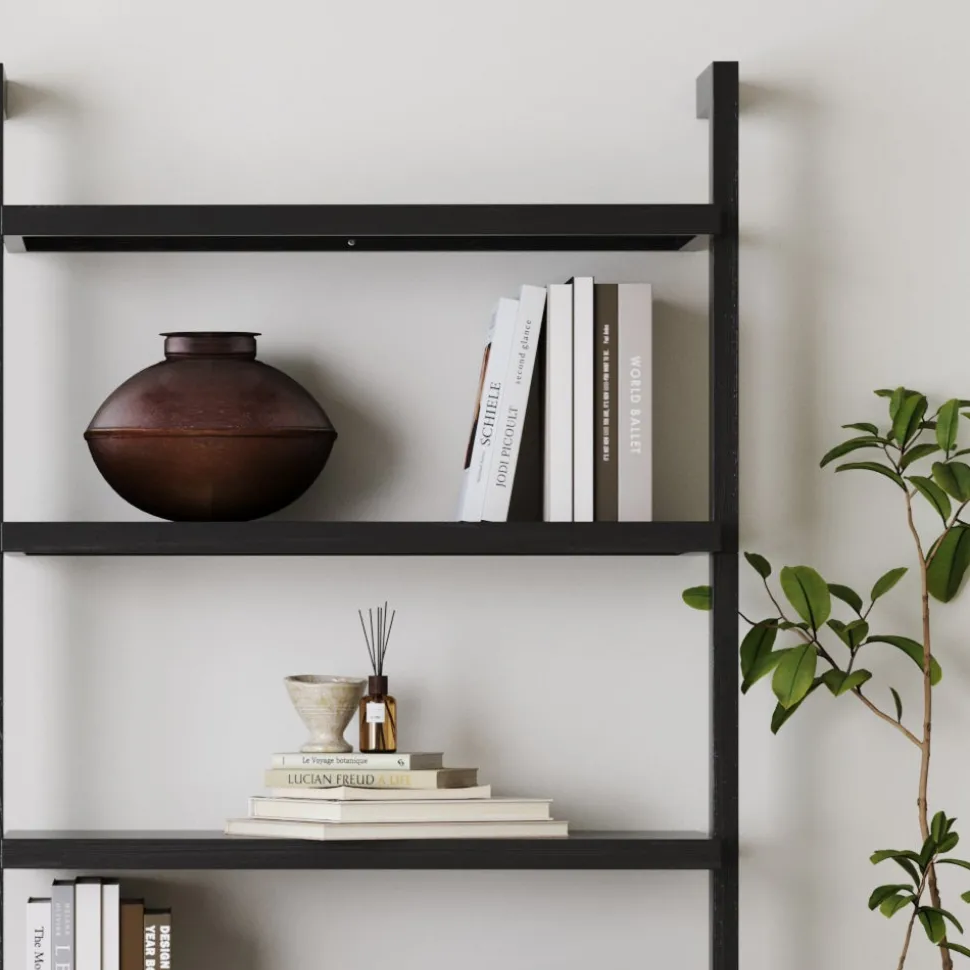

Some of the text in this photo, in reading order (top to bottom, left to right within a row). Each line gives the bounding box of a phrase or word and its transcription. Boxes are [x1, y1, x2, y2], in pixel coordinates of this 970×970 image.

[515, 319, 532, 384] second glance
[481, 381, 501, 446] SCHIELE
[630, 356, 642, 454] WORLD BALLET
[496, 405, 518, 488] JODI PICOULT
[288, 773, 332, 785] LUCIAN
[336, 773, 375, 785] FREUD
[311, 757, 334, 766] Voyage
[336, 757, 368, 766] botanique
[34, 925, 45, 948] The
[144, 924, 156, 956] YEAR
[159, 924, 171, 969] DESIGN
